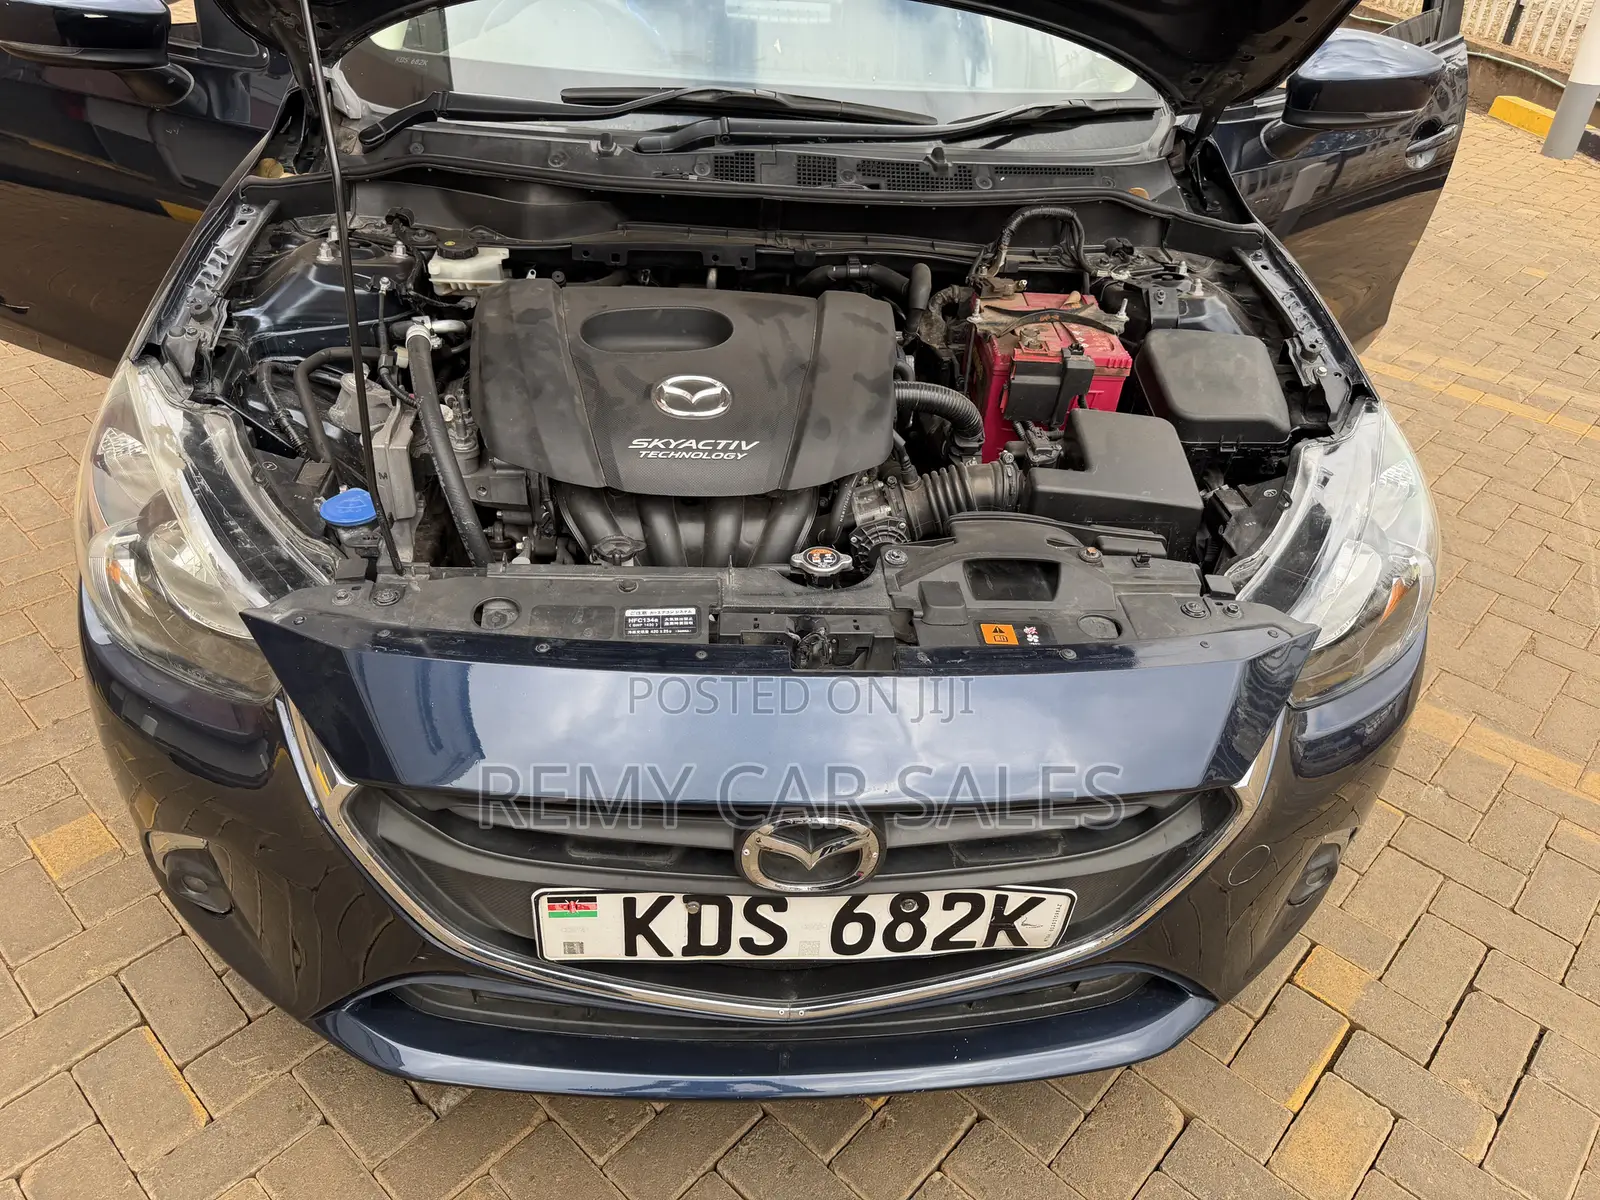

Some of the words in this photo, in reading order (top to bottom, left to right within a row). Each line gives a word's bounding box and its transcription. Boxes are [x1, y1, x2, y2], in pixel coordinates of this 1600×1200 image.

[628, 438, 760, 451] SKYACTIV
[638, 450, 748, 460] TECHNOLOGY
[622, 894, 789, 958] KDS
[830, 892, 1047, 957] 682K
